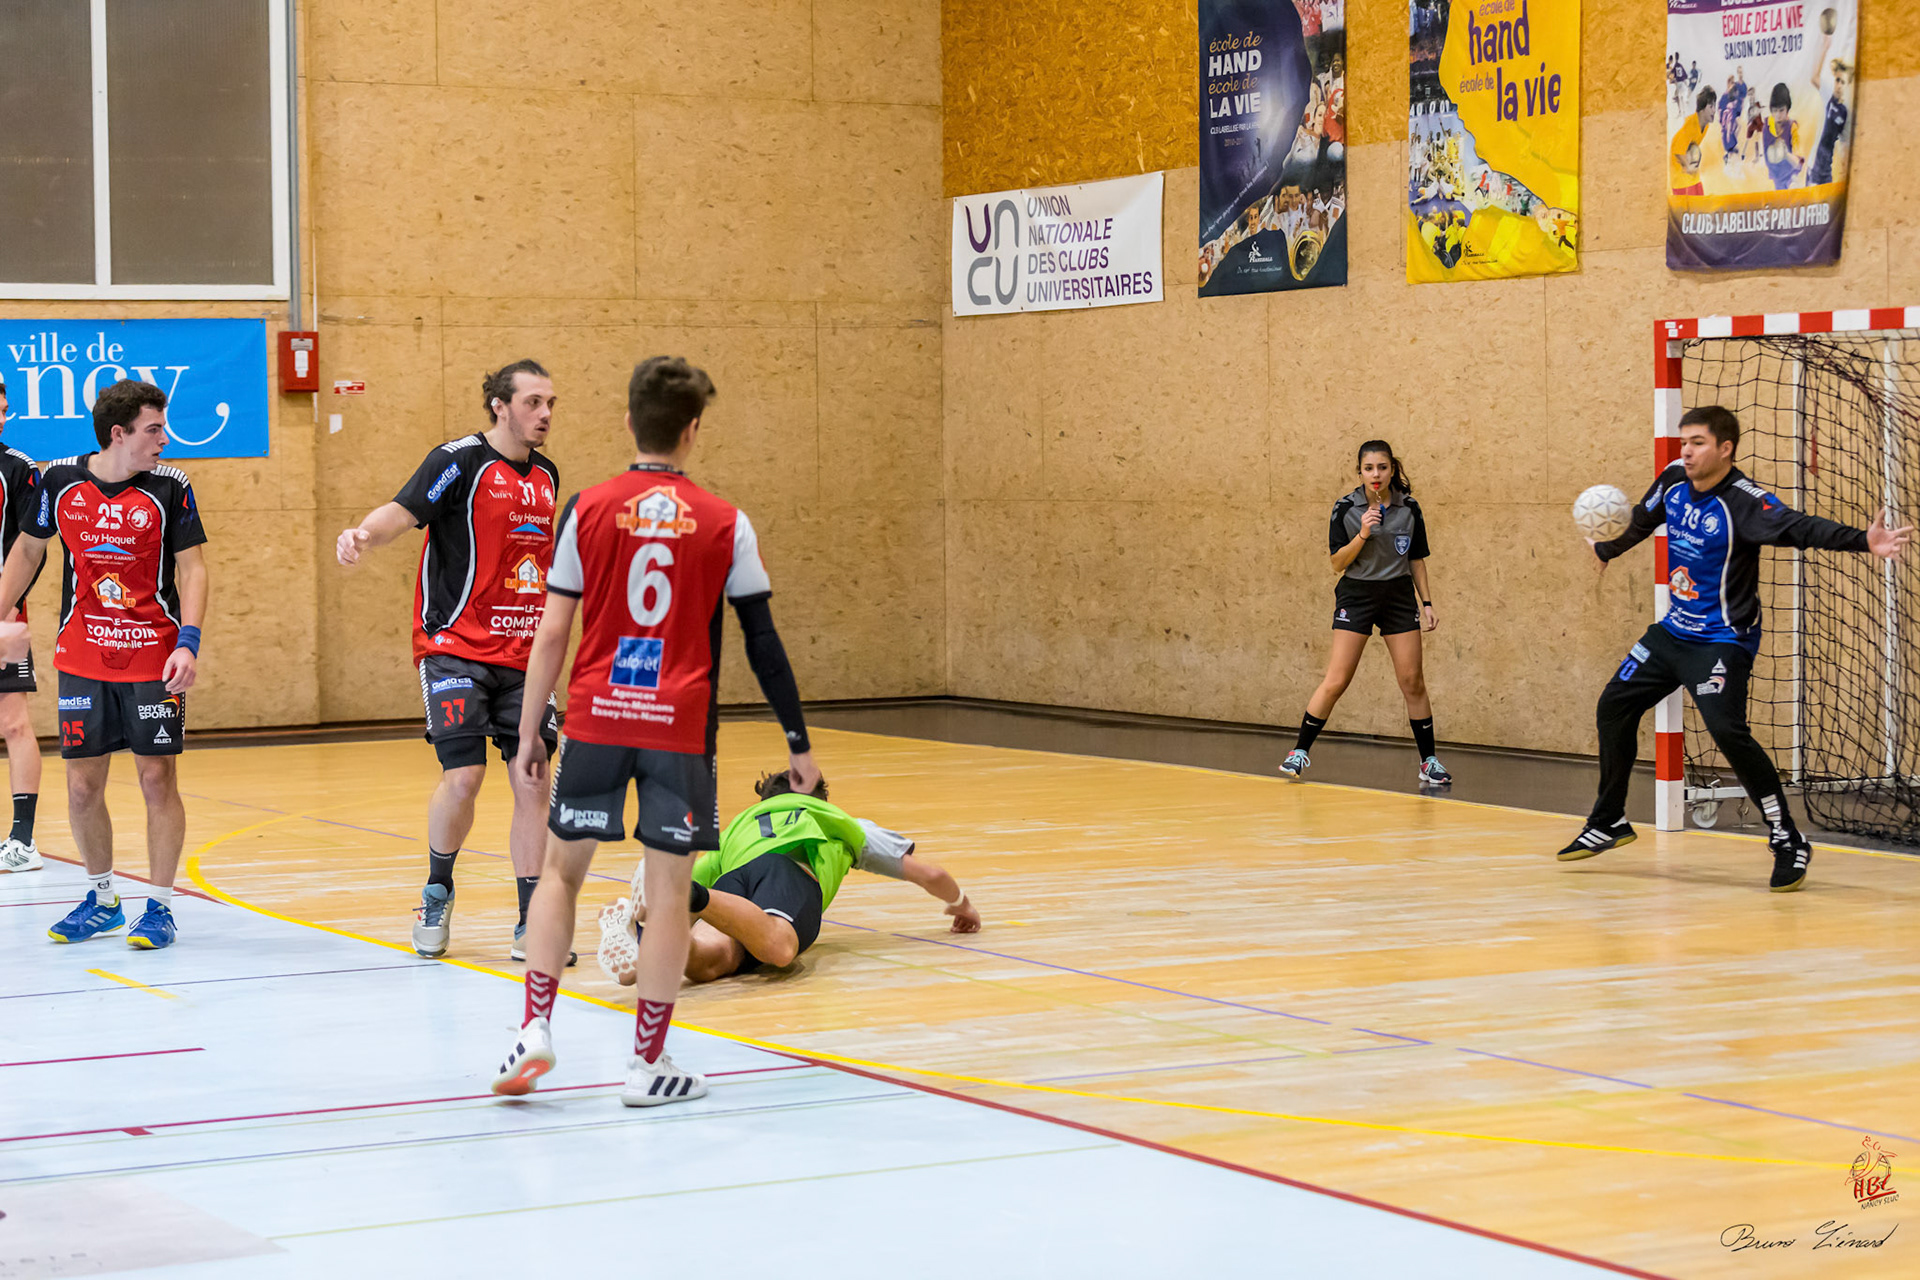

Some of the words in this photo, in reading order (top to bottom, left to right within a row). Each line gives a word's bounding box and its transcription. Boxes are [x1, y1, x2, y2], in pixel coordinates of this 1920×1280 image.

[1469, 0, 1530, 65] hand
[1722, 9, 1753, 37] ÉCOLE
[1754, 10, 1768, 34] DE
[1770, 8, 1782, 31] LA
[1785, 5, 1804, 29] VIE
[1209, 34, 1242, 53] école
[1243, 31, 1263, 48] de
[1725, 39, 1754, 60] SAISON
[1755, 33, 1803, 56] 2012-2013
[1208, 49, 1262, 77] HAND
[1208, 76, 1240, 95] école
[1242, 72, 1259, 90] de
[1459, 75, 1483, 93] école
[1484, 72, 1495, 90] de
[1496, 67, 1518, 122] la
[1524, 62, 1561, 117] vie
[1209, 96, 1231, 119] LA
[1234, 92, 1261, 116] VIE
[1027, 195, 1071, 218] UNION
[1681, 213, 1714, 234] CLUB
[1715, 205, 1769, 234] LABELLISÉ
[1770, 208, 1792, 231] PAR
[1792, 206, 1804, 229] LA
[1806, 203, 1830, 226] FFHB
[1029, 218, 1113, 246] NATIONALE
[1028, 253, 1056, 274] DES
[1058, 247, 1109, 272] CLUBS
[1027, 271, 1153, 303] UNIVERSITAIRES
[7, 332, 78, 363] ville
[86, 332, 124, 363] de
[0, 364, 230, 446] ncy
[94, 502, 123, 530] 25
[509, 511, 523, 524] Guy
[524, 512, 550, 526] Hoquet
[80, 531, 99, 544] Guy
[101, 533, 136, 546] Hoquet
[627, 542, 674, 627] 6
[490, 615, 541, 629] COMPT
[524, 604, 535, 613] LE
[86, 624, 158, 640] COMPTOIR
[505, 628, 534, 640] Campa
[611, 688, 657, 701] Agences
[441, 698, 465, 727] 37
[62, 720, 85, 747] 25
